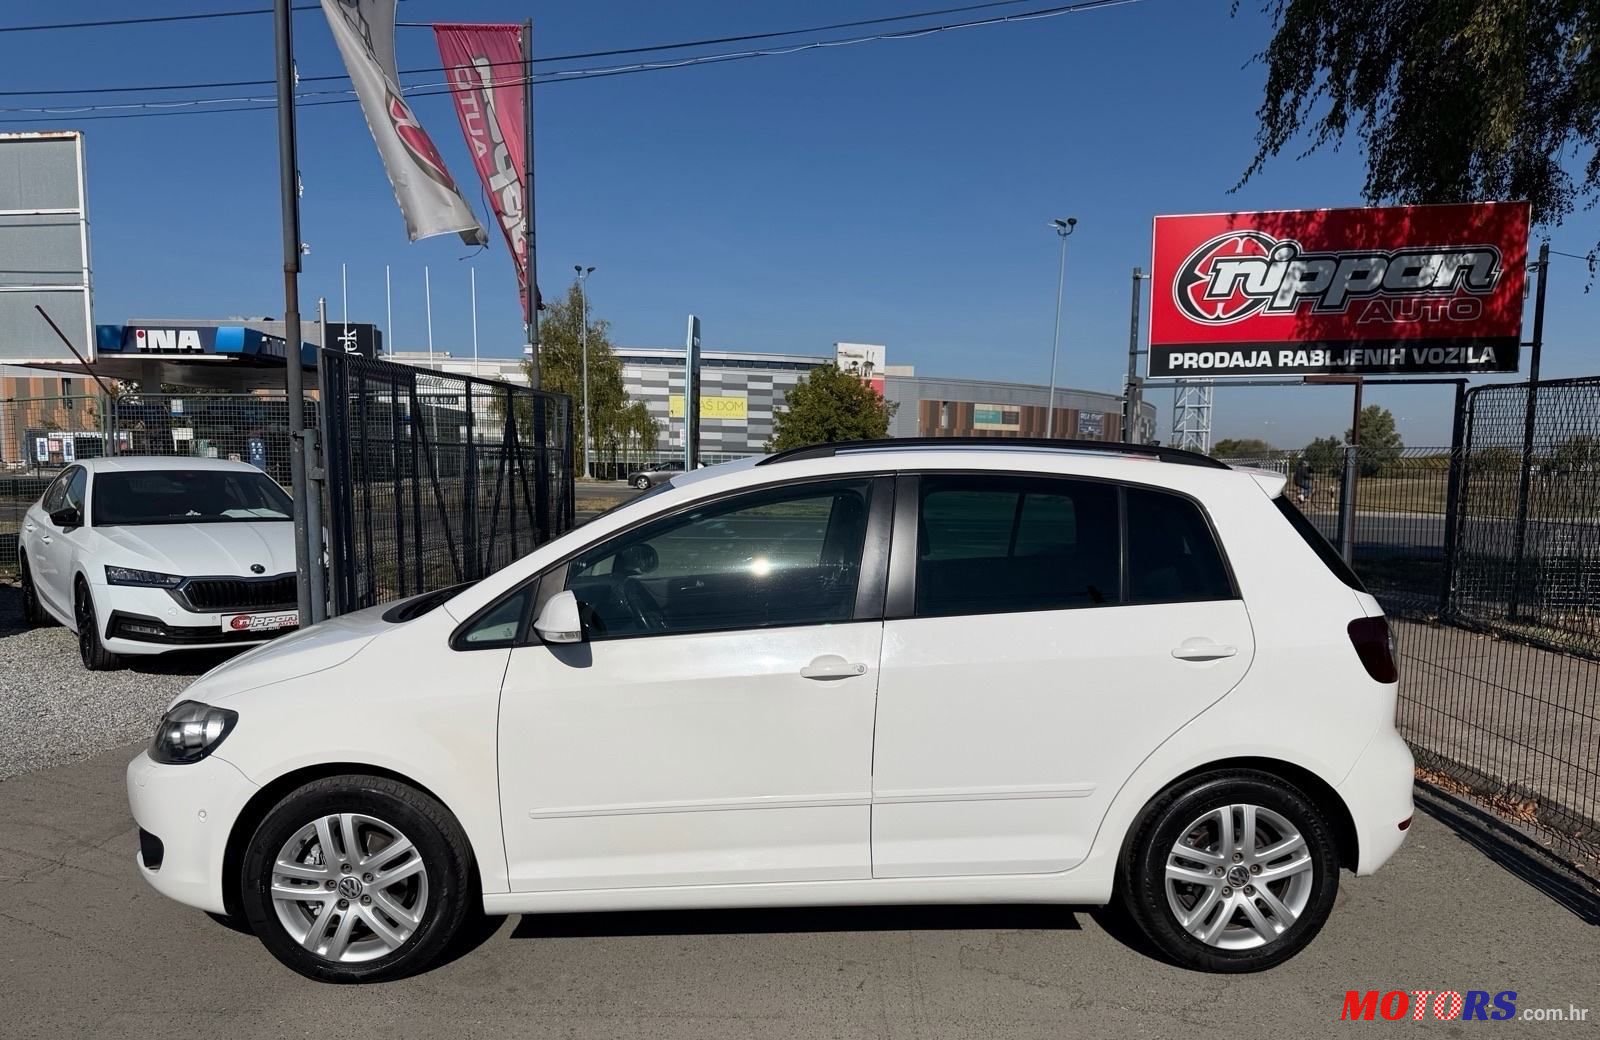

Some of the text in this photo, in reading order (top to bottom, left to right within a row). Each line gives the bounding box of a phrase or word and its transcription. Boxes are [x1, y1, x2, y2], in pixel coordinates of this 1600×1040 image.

[1208, 240, 1501, 313] nippon
[1357, 298, 1482, 325] AUTO
[1168, 346, 1497, 369] PRODAJA RABLJENIH VOZILA
[700, 399, 744, 411] AŠ DOM
[239, 614, 298, 627] nippon
